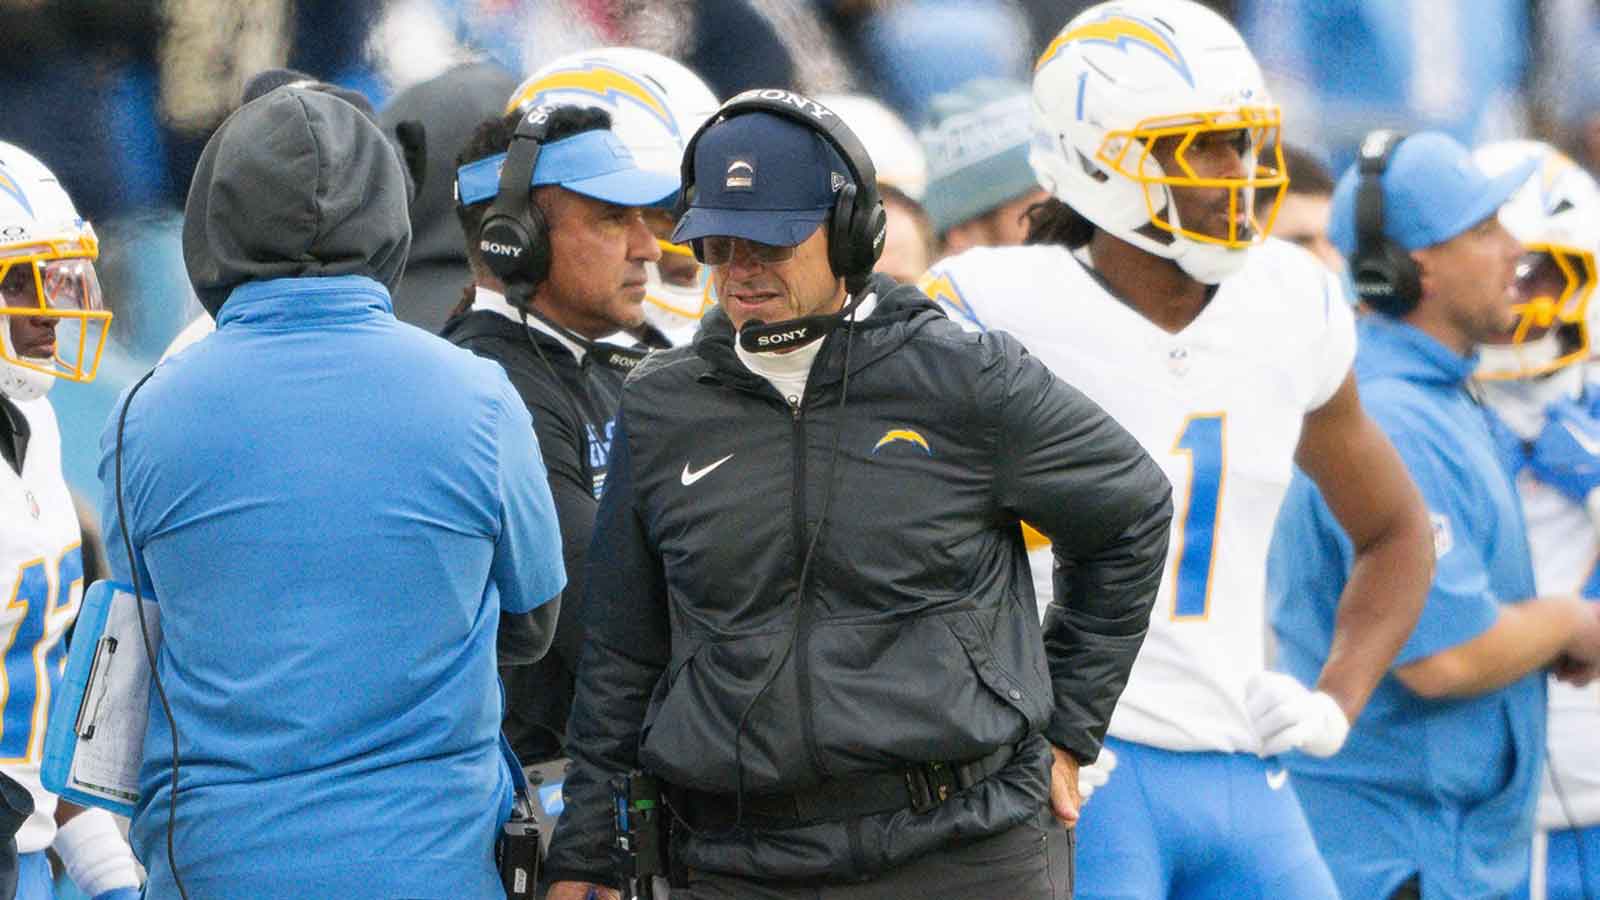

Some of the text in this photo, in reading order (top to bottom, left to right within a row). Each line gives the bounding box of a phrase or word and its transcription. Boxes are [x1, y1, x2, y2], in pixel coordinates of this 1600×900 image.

[480, 240, 523, 257] SONY
[758, 328, 808, 345] SONY
[609, 353, 641, 367] SON
[1169, 411, 1227, 622] 1
